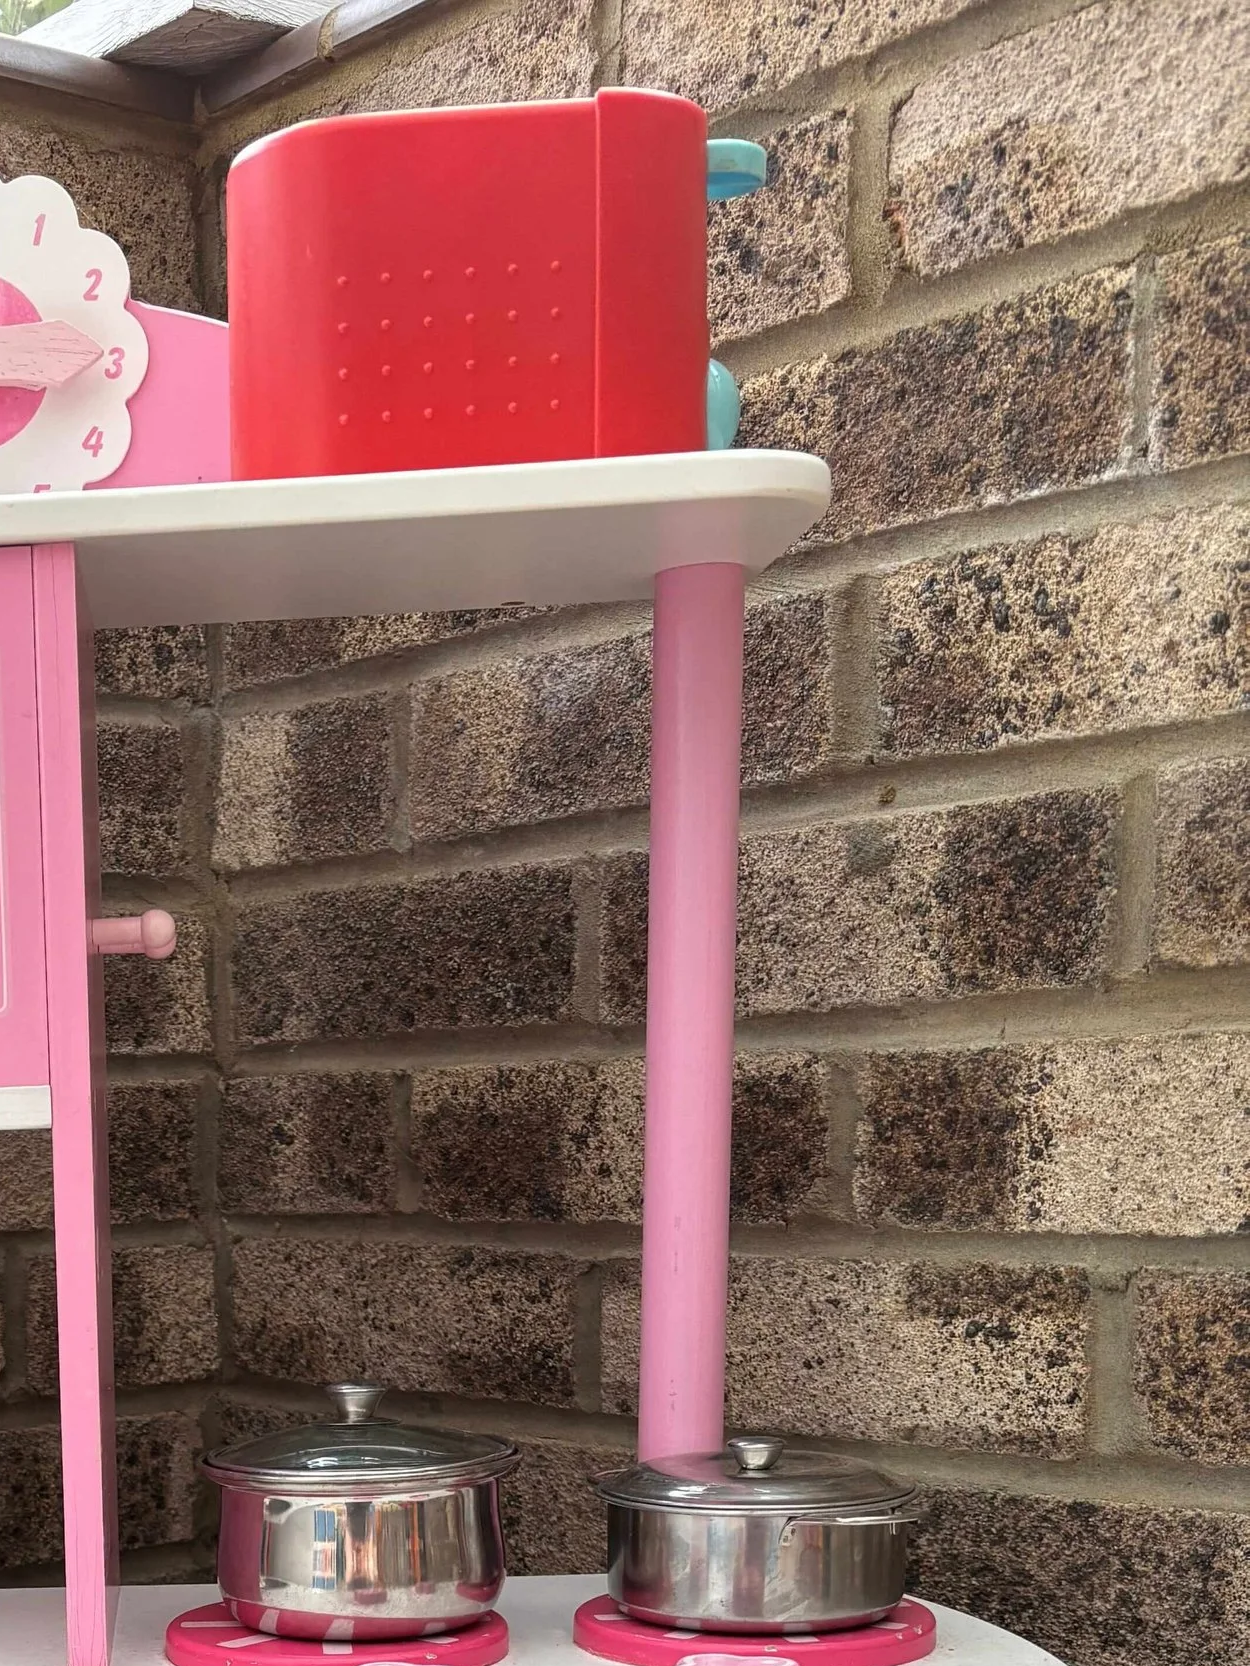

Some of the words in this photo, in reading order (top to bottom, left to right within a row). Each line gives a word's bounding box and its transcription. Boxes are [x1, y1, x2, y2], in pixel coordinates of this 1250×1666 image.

[32, 213, 46, 246] 1
[82, 268, 103, 301] 2
[104, 347, 126, 380] 3
[82, 426, 103, 458] 4
